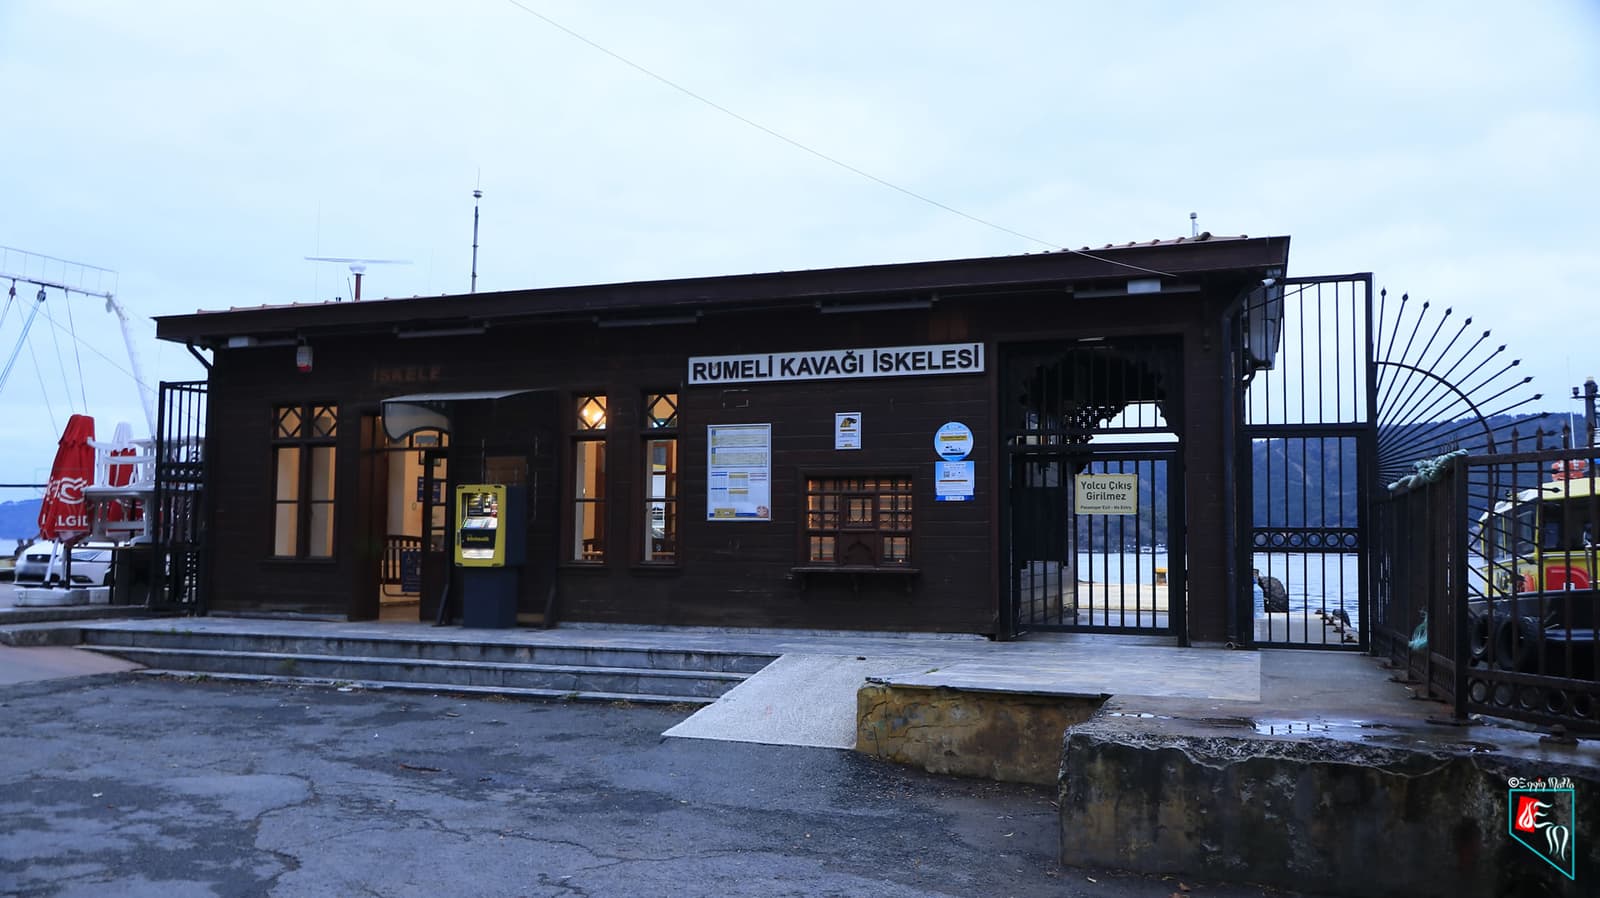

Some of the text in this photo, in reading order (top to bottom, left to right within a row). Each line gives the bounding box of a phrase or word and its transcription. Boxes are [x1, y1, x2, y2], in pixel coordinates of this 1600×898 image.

[693, 344, 979, 380] RUMELİ KAVAĞI İSKELESİ
[1080, 481, 1133, 491] Yolcu Çıkış
[1086, 491, 1127, 501] Girilmez
